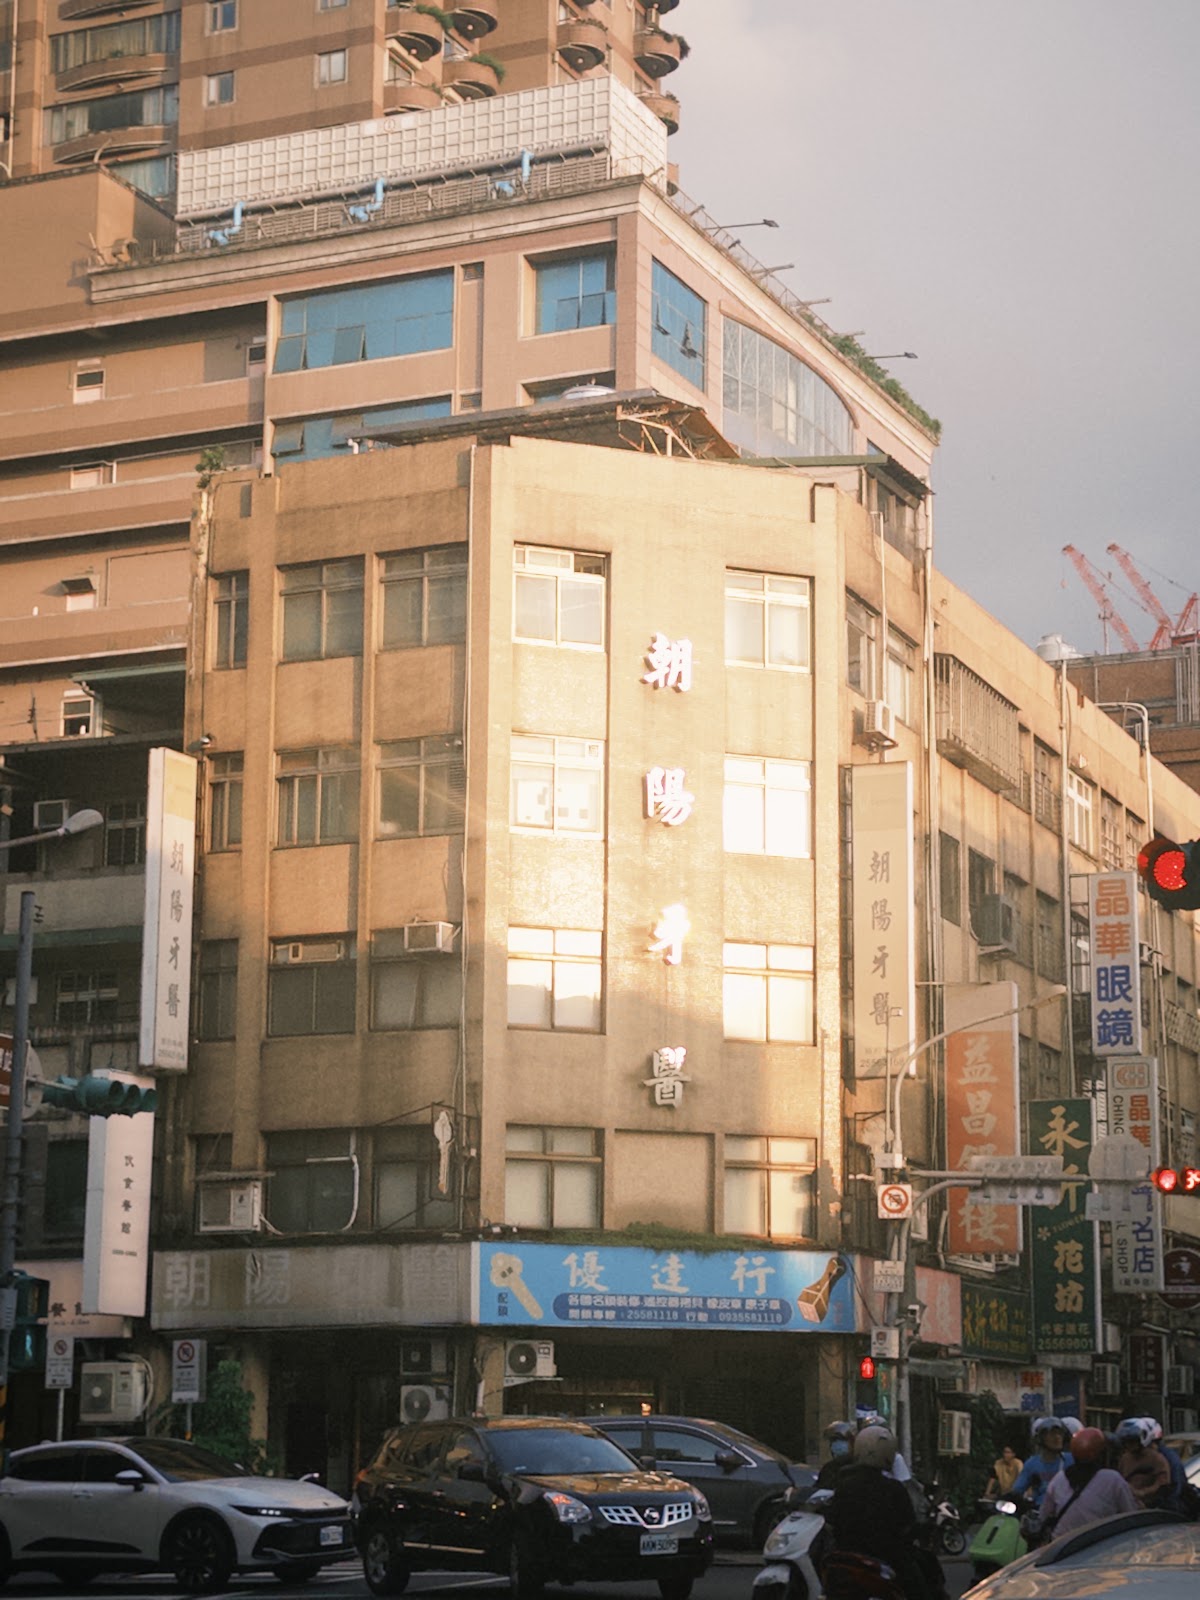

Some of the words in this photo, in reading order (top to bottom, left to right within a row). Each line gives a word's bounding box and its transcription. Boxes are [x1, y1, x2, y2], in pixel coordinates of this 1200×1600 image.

[644, 633, 693, 1107] 朝陽牙醫
[868, 850, 893, 1028] 朝陽牙醫
[1095, 878, 1134, 1048] 晶華眼鏡
[1113, 1094, 1125, 1135] CHING
[1117, 1238, 1129, 1274] SHOP
